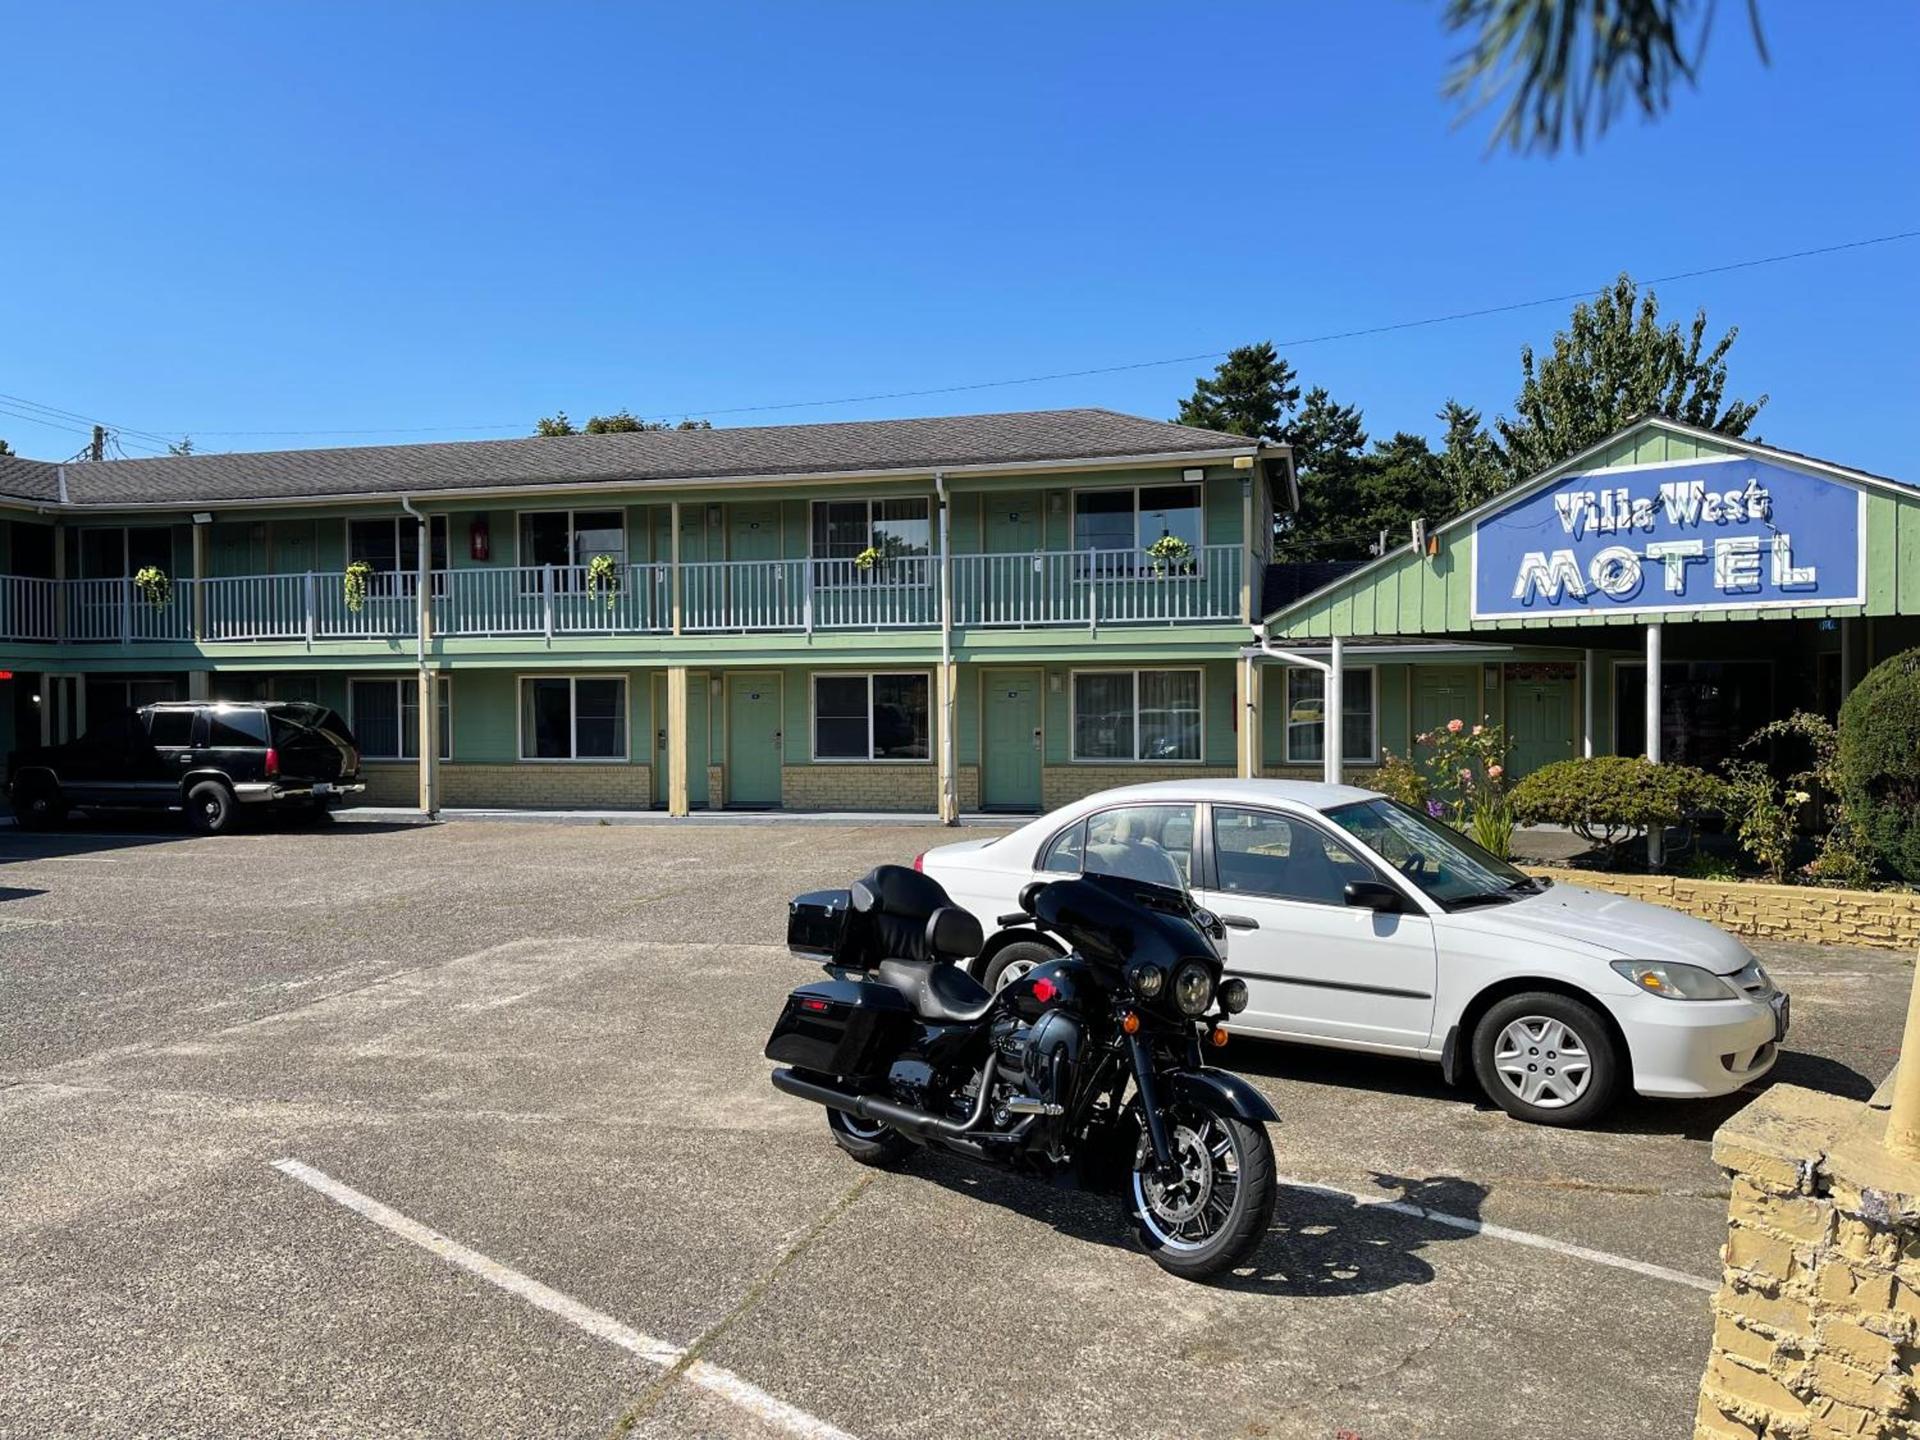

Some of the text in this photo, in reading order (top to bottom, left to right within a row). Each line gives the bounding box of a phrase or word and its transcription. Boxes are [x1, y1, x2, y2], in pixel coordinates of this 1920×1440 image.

[1554, 478, 1769, 533] Villa West
[1511, 534, 1817, 600] MOTEL
